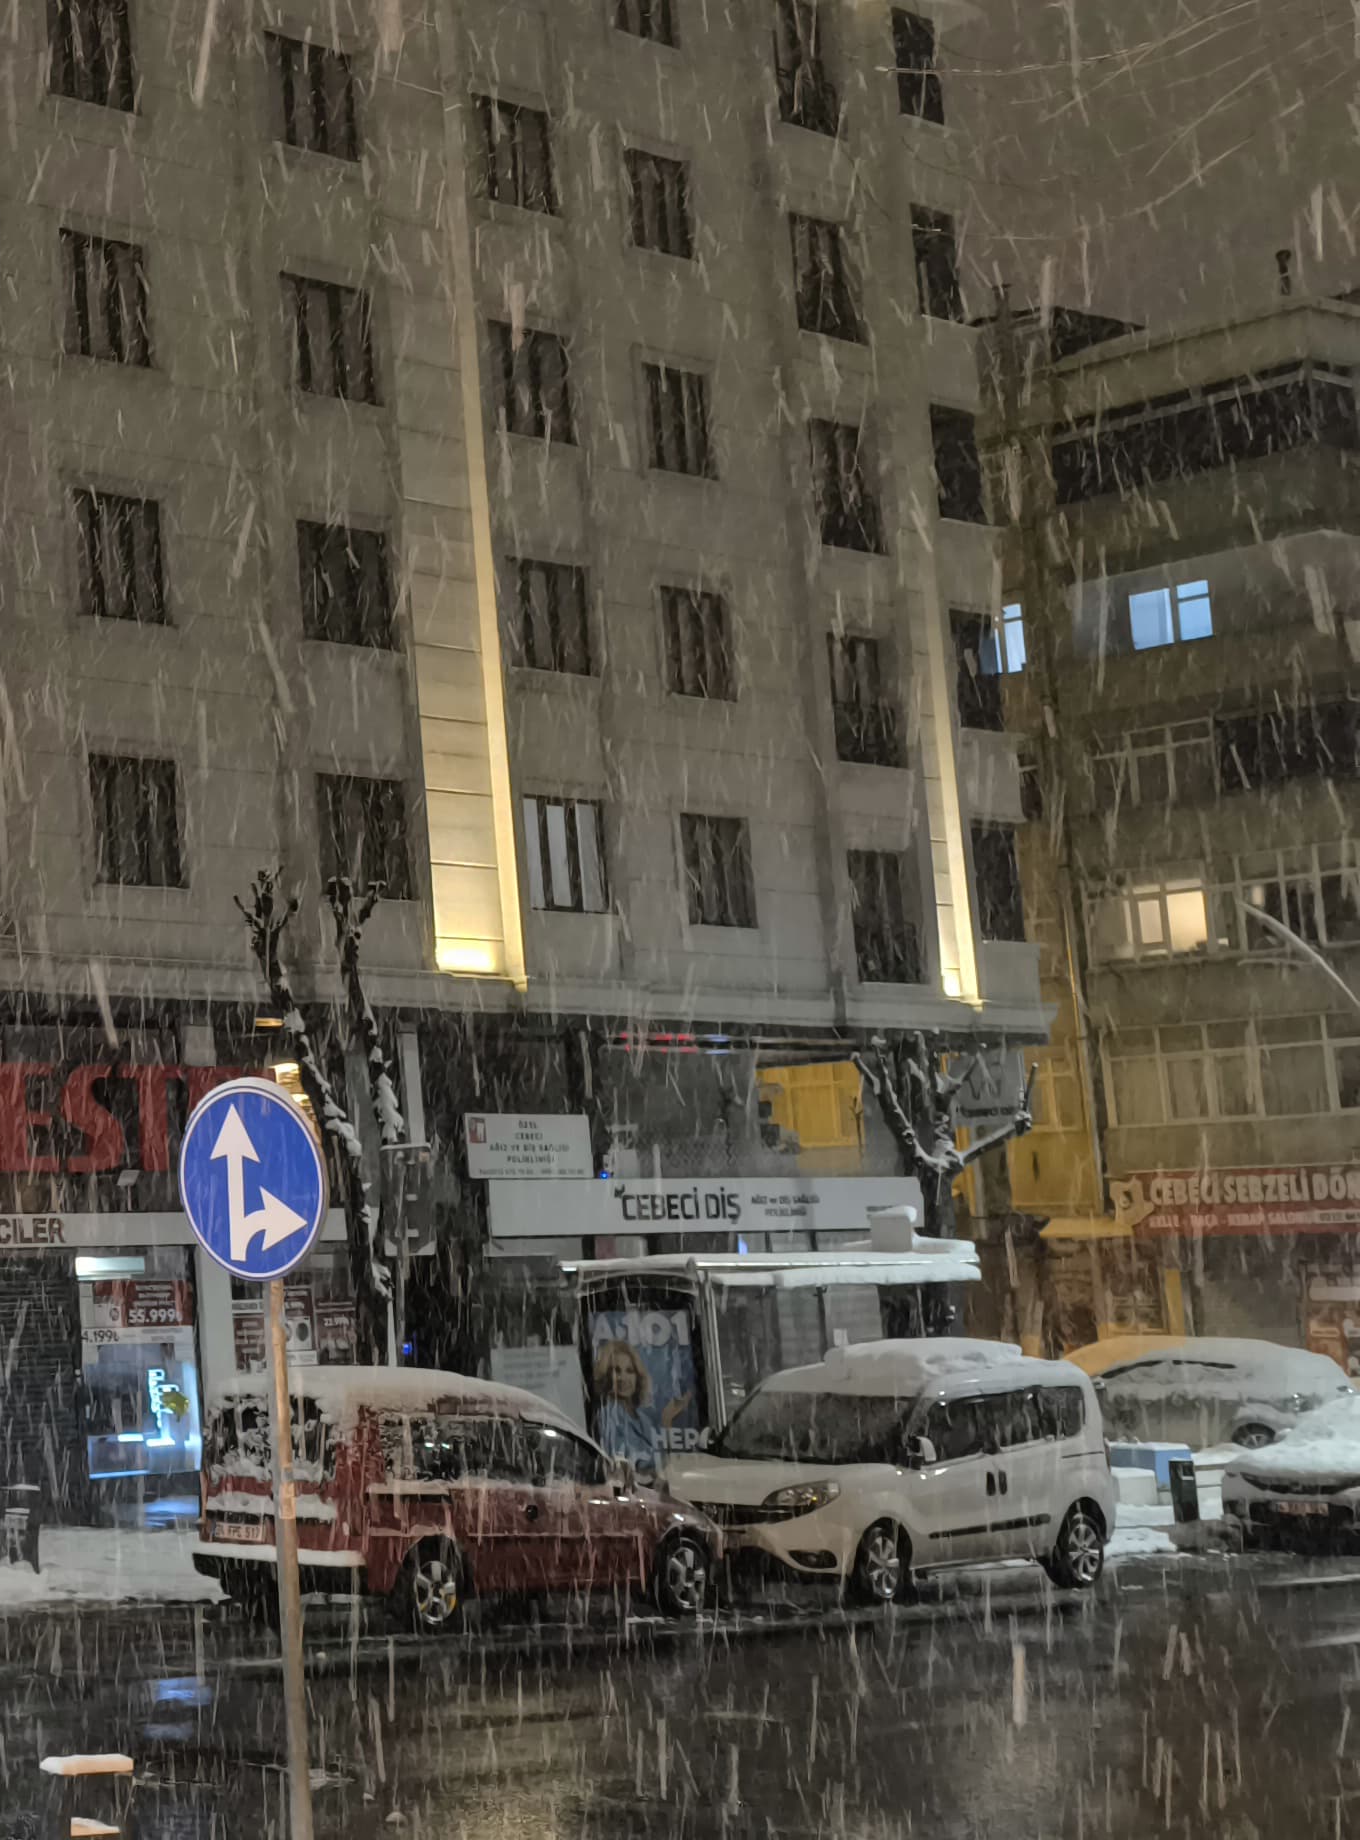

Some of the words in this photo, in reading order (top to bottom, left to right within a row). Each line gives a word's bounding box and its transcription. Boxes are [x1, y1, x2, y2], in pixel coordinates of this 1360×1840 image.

[1223, 1167, 1310, 1204] SEBZELİ
[621, 1186, 700, 1221] CEBECİ
[705, 1186, 742, 1225] DİŞ
